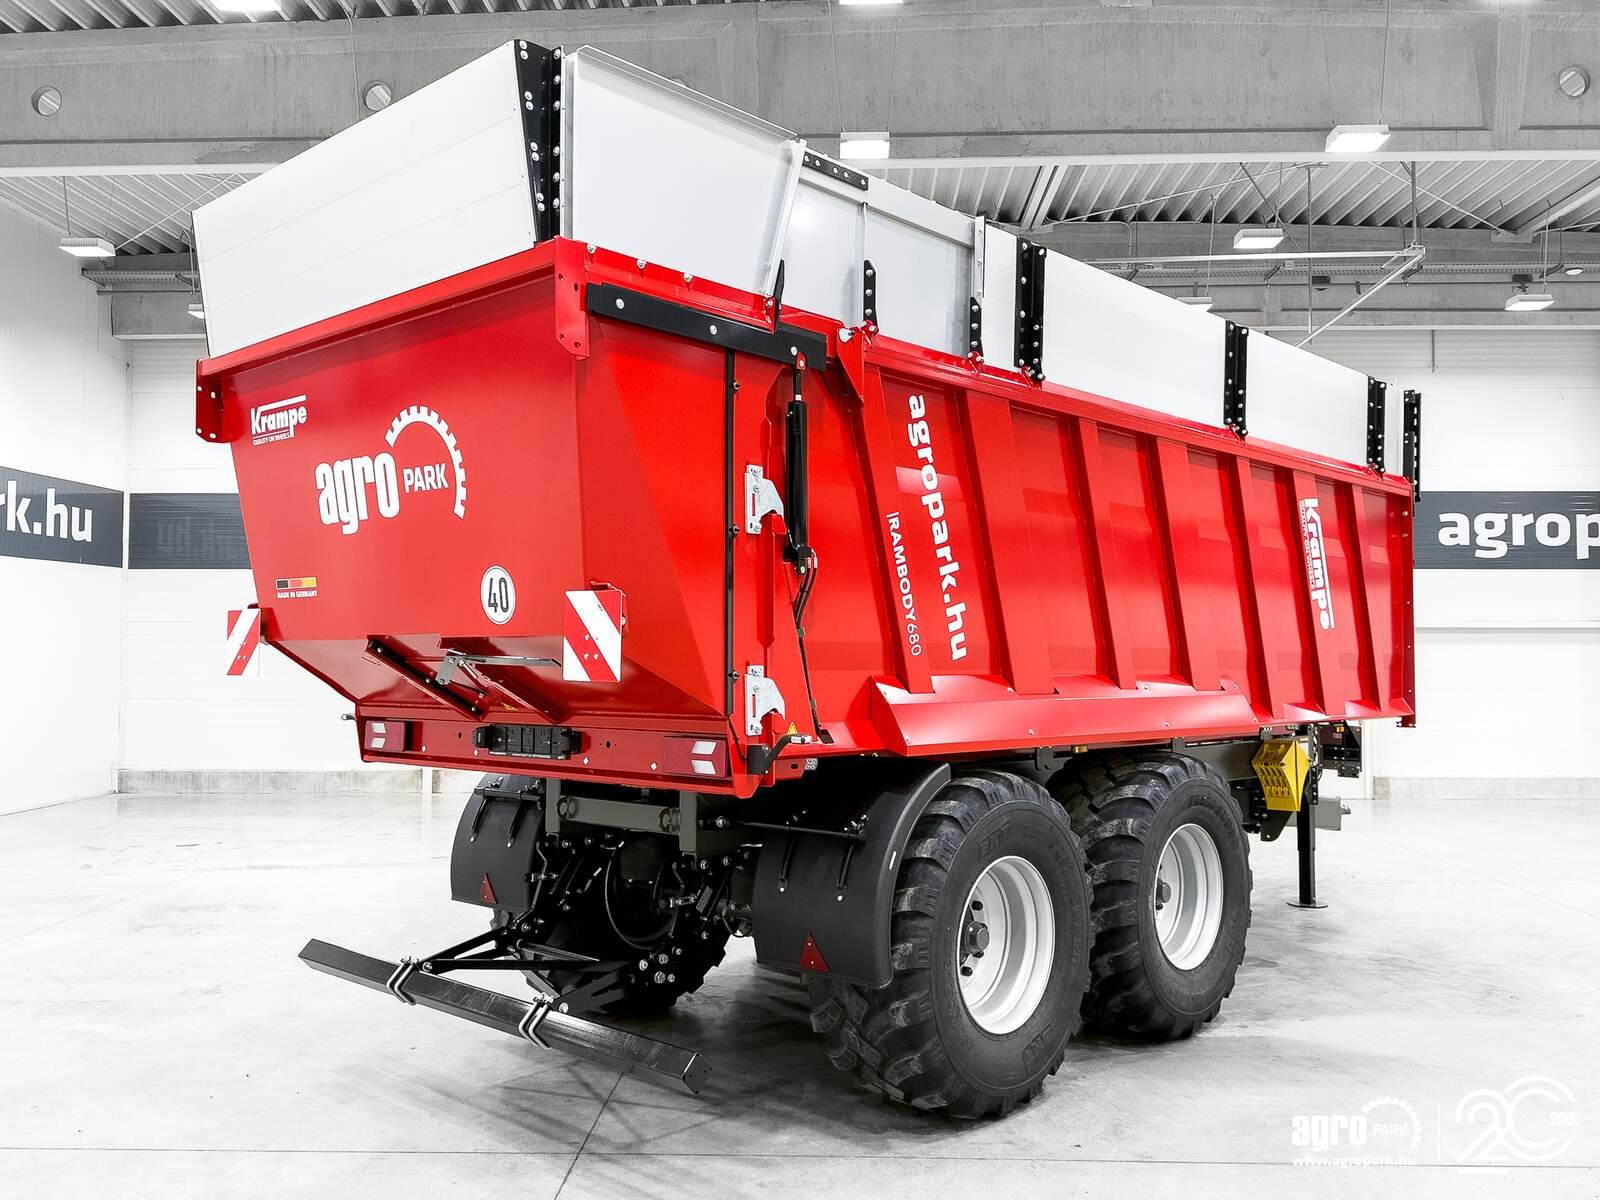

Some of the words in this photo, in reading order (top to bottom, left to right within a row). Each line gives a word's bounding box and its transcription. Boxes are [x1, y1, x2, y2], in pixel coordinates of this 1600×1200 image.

[250, 394, 307, 438] Krampe
[315, 452, 400, 535] agro
[402, 463, 449, 493] PARK
[908, 395, 968, 661] agropark.hu
[1437, 512, 1600, 560] agrop
[487, 577, 510, 613] 40
[1304, 498, 1335, 630] Krampe
